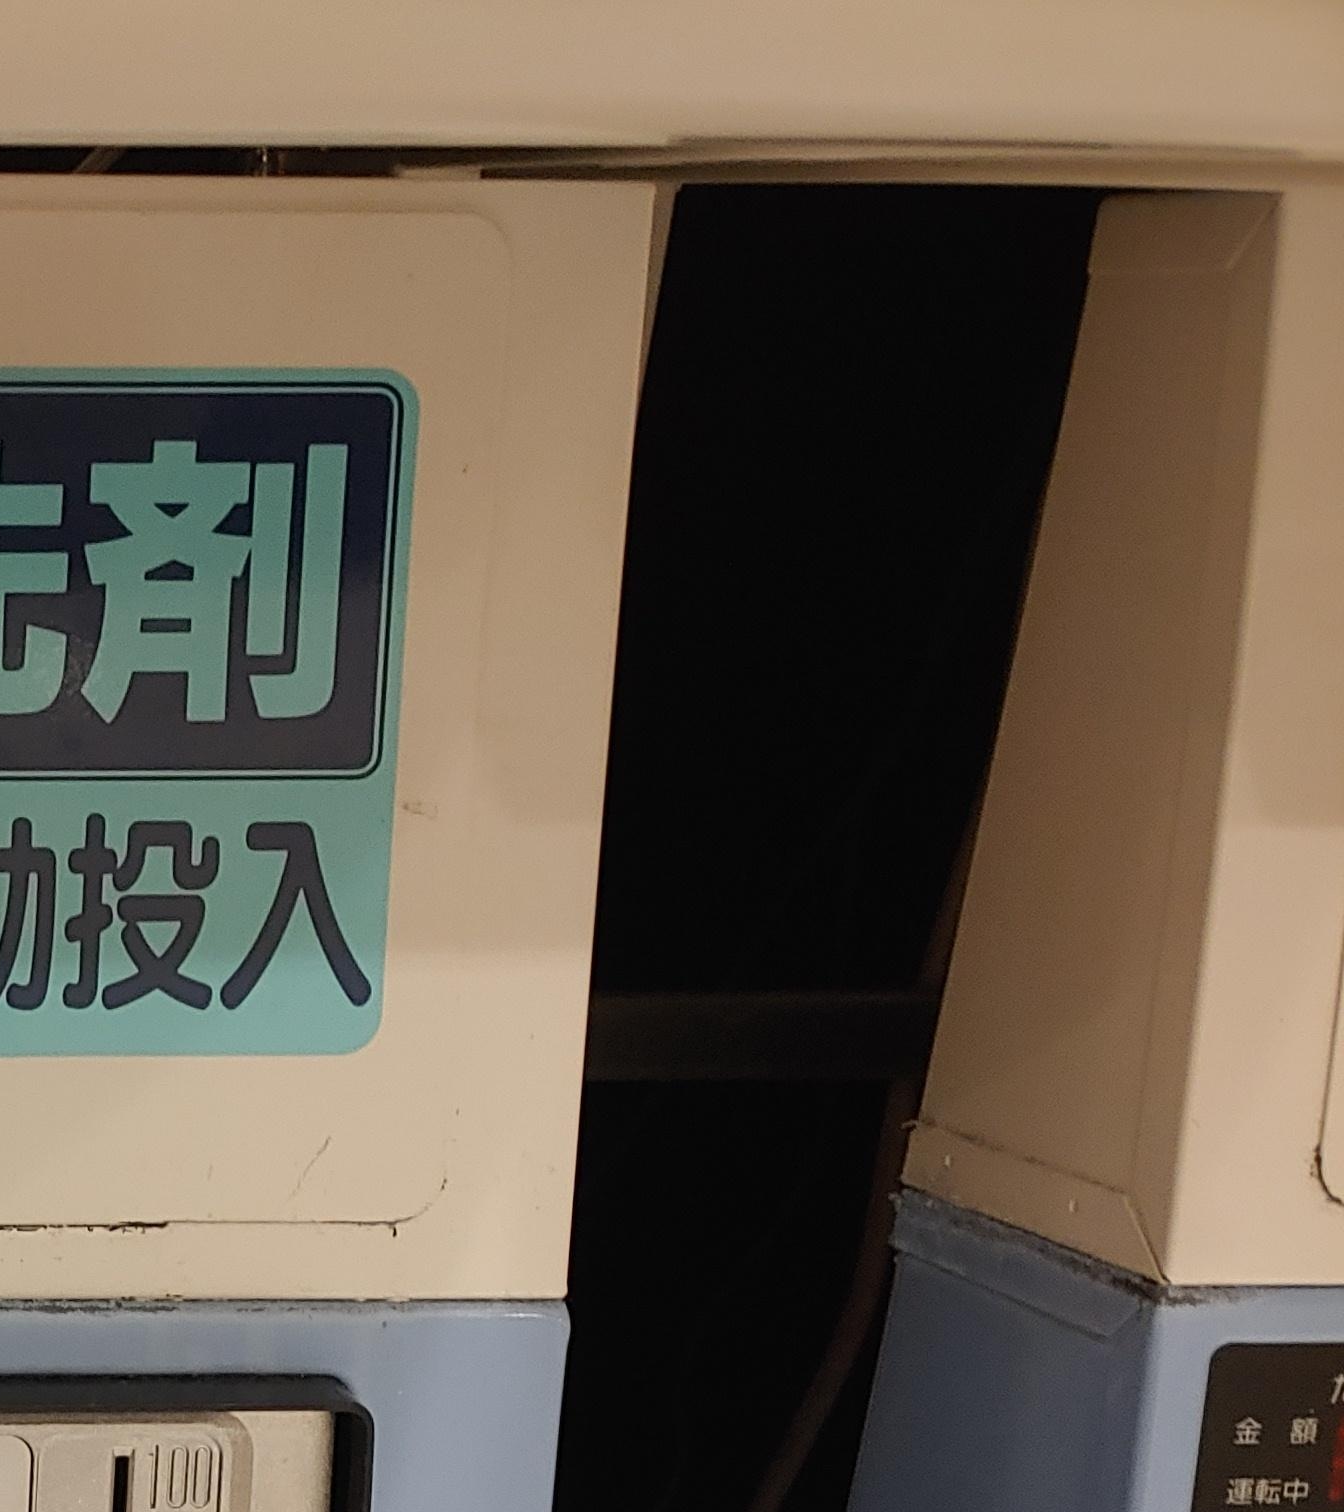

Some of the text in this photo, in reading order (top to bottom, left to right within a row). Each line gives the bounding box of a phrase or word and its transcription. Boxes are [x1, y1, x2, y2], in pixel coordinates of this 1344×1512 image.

[149, 1444, 211, 1509] 100
[1226, 1477, 1309, 1505] 運転中
